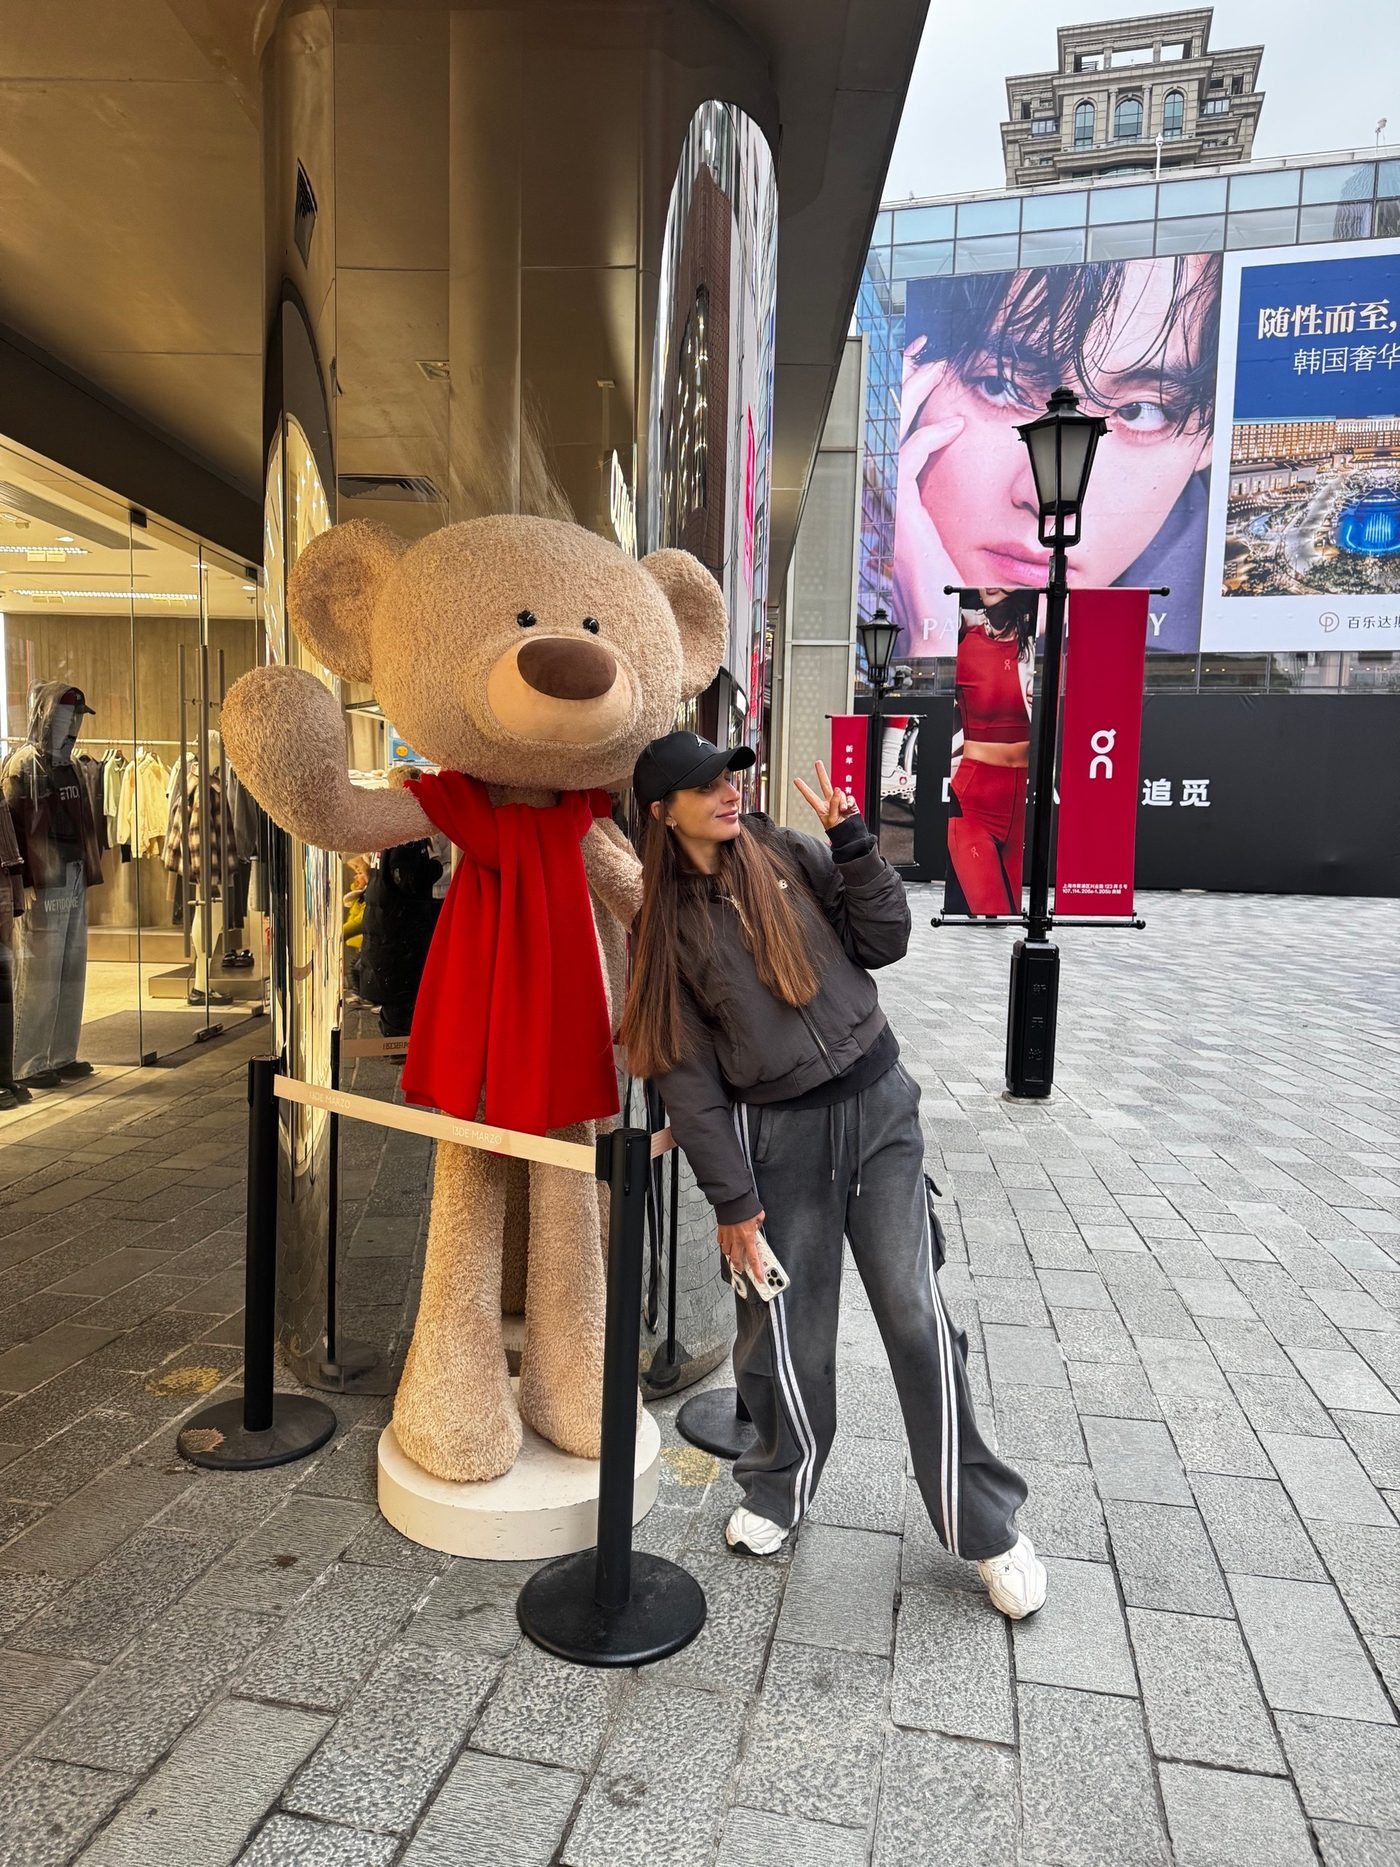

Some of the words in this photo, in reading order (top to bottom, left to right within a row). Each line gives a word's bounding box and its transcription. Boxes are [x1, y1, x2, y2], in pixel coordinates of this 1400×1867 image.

[1293, 342, 1400, 375] 韩国奢华
[1141, 778, 1212, 807] 追觅
[471, 1130, 502, 1145] MARZO
